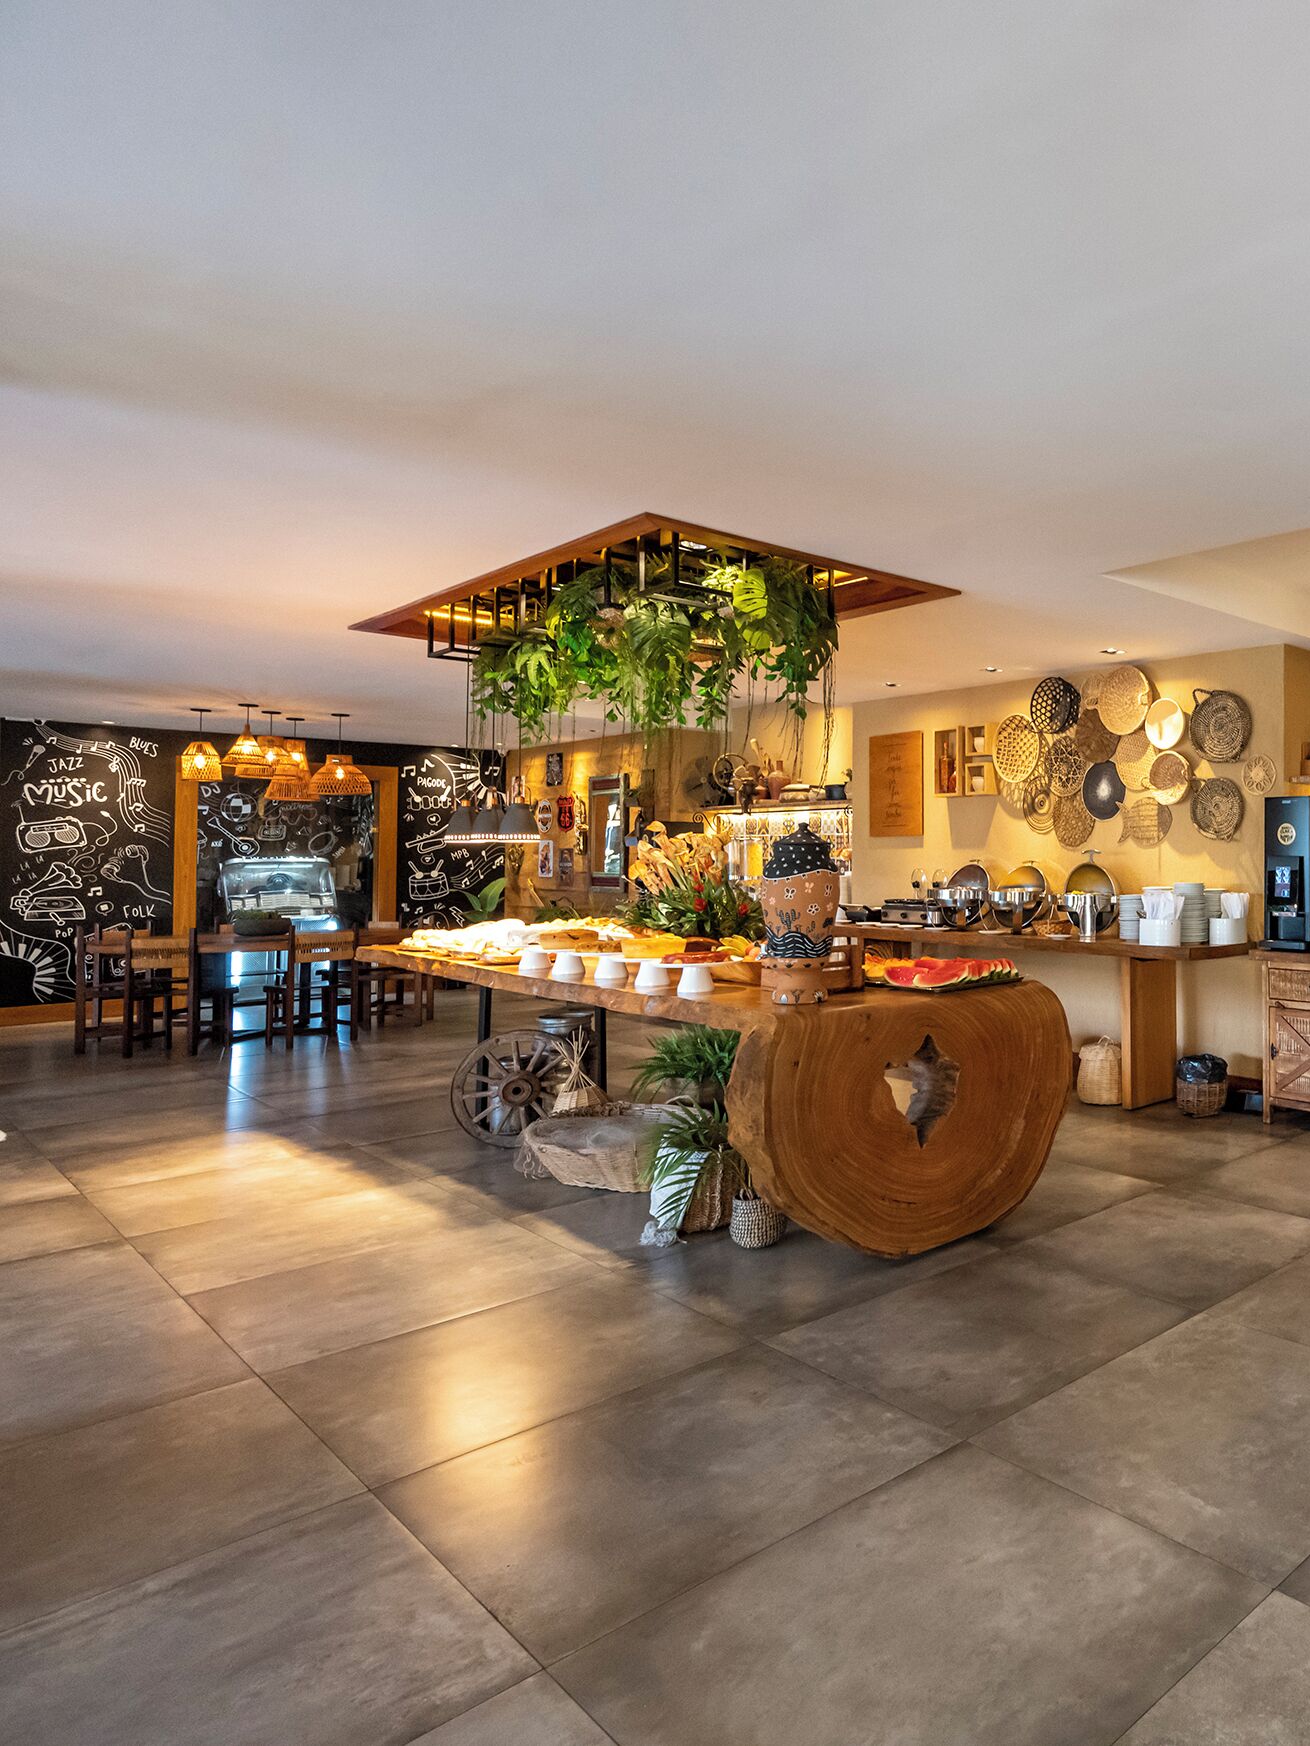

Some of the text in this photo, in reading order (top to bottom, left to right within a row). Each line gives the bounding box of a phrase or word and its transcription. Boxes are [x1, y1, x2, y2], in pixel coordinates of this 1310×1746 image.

[129, 736, 160, 758] BLUES
[47, 756, 84, 773] JAZZ
[201, 782, 221, 798] DJ
[417, 776, 447, 789] PAGODE
[451, 848, 470, 861] MPB
[123, 904, 156, 918] FOLK
